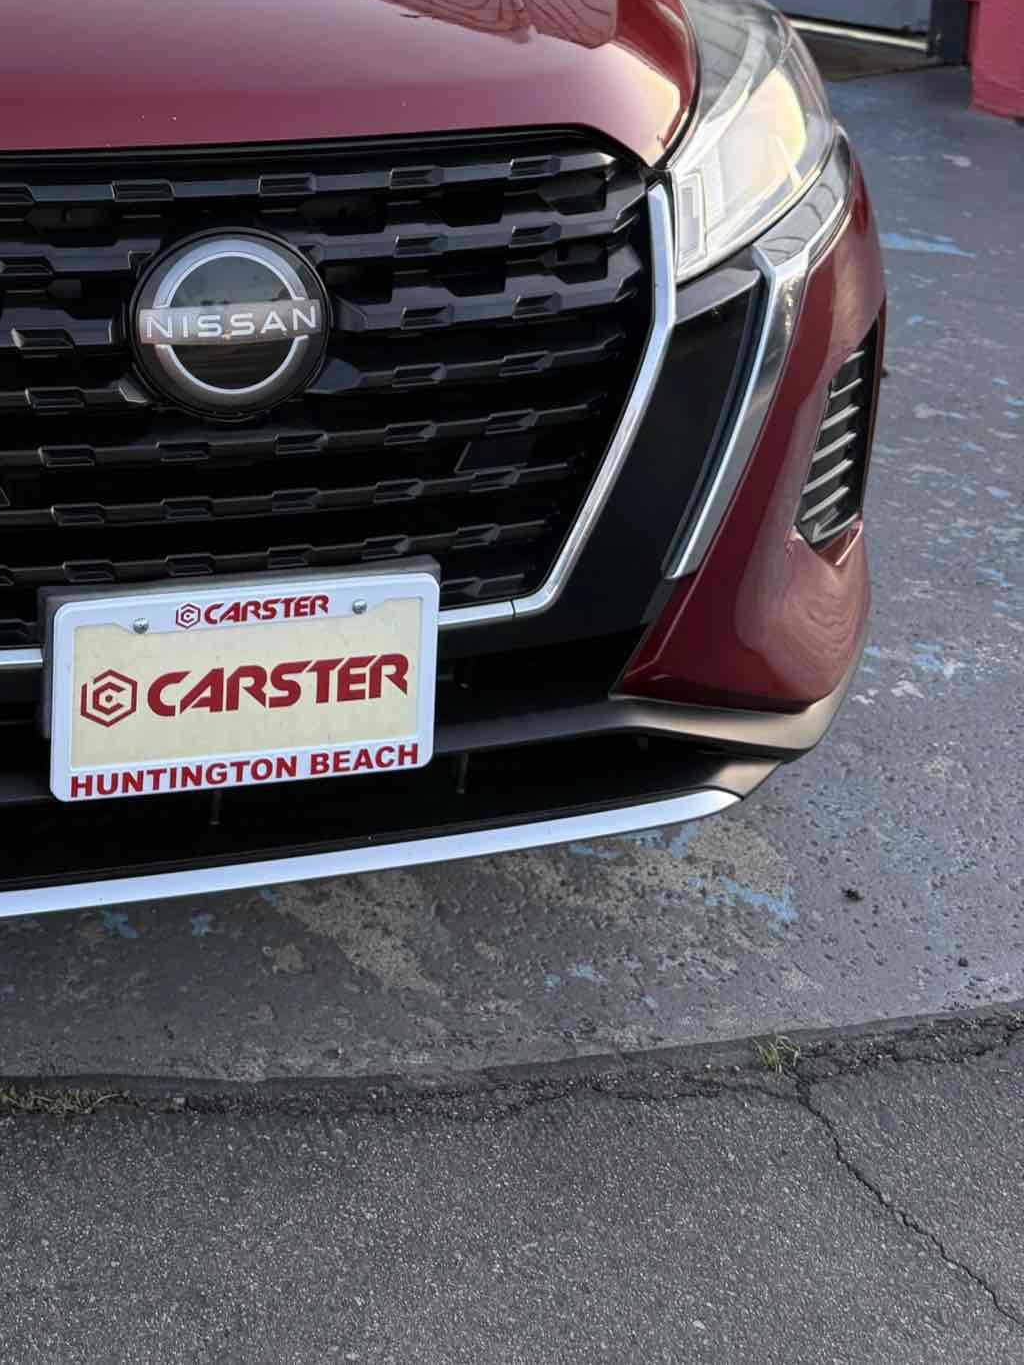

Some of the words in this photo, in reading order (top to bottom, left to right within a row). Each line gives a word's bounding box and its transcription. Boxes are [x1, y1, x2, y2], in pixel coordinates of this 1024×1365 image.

[146, 306, 317, 338] NISSAN
[204, 594, 329, 624] CARSTER
[147, 653, 408, 716] CARSTER
[70, 755, 297, 798] HUNTINGTON
[310, 743, 419, 775] BEACH
